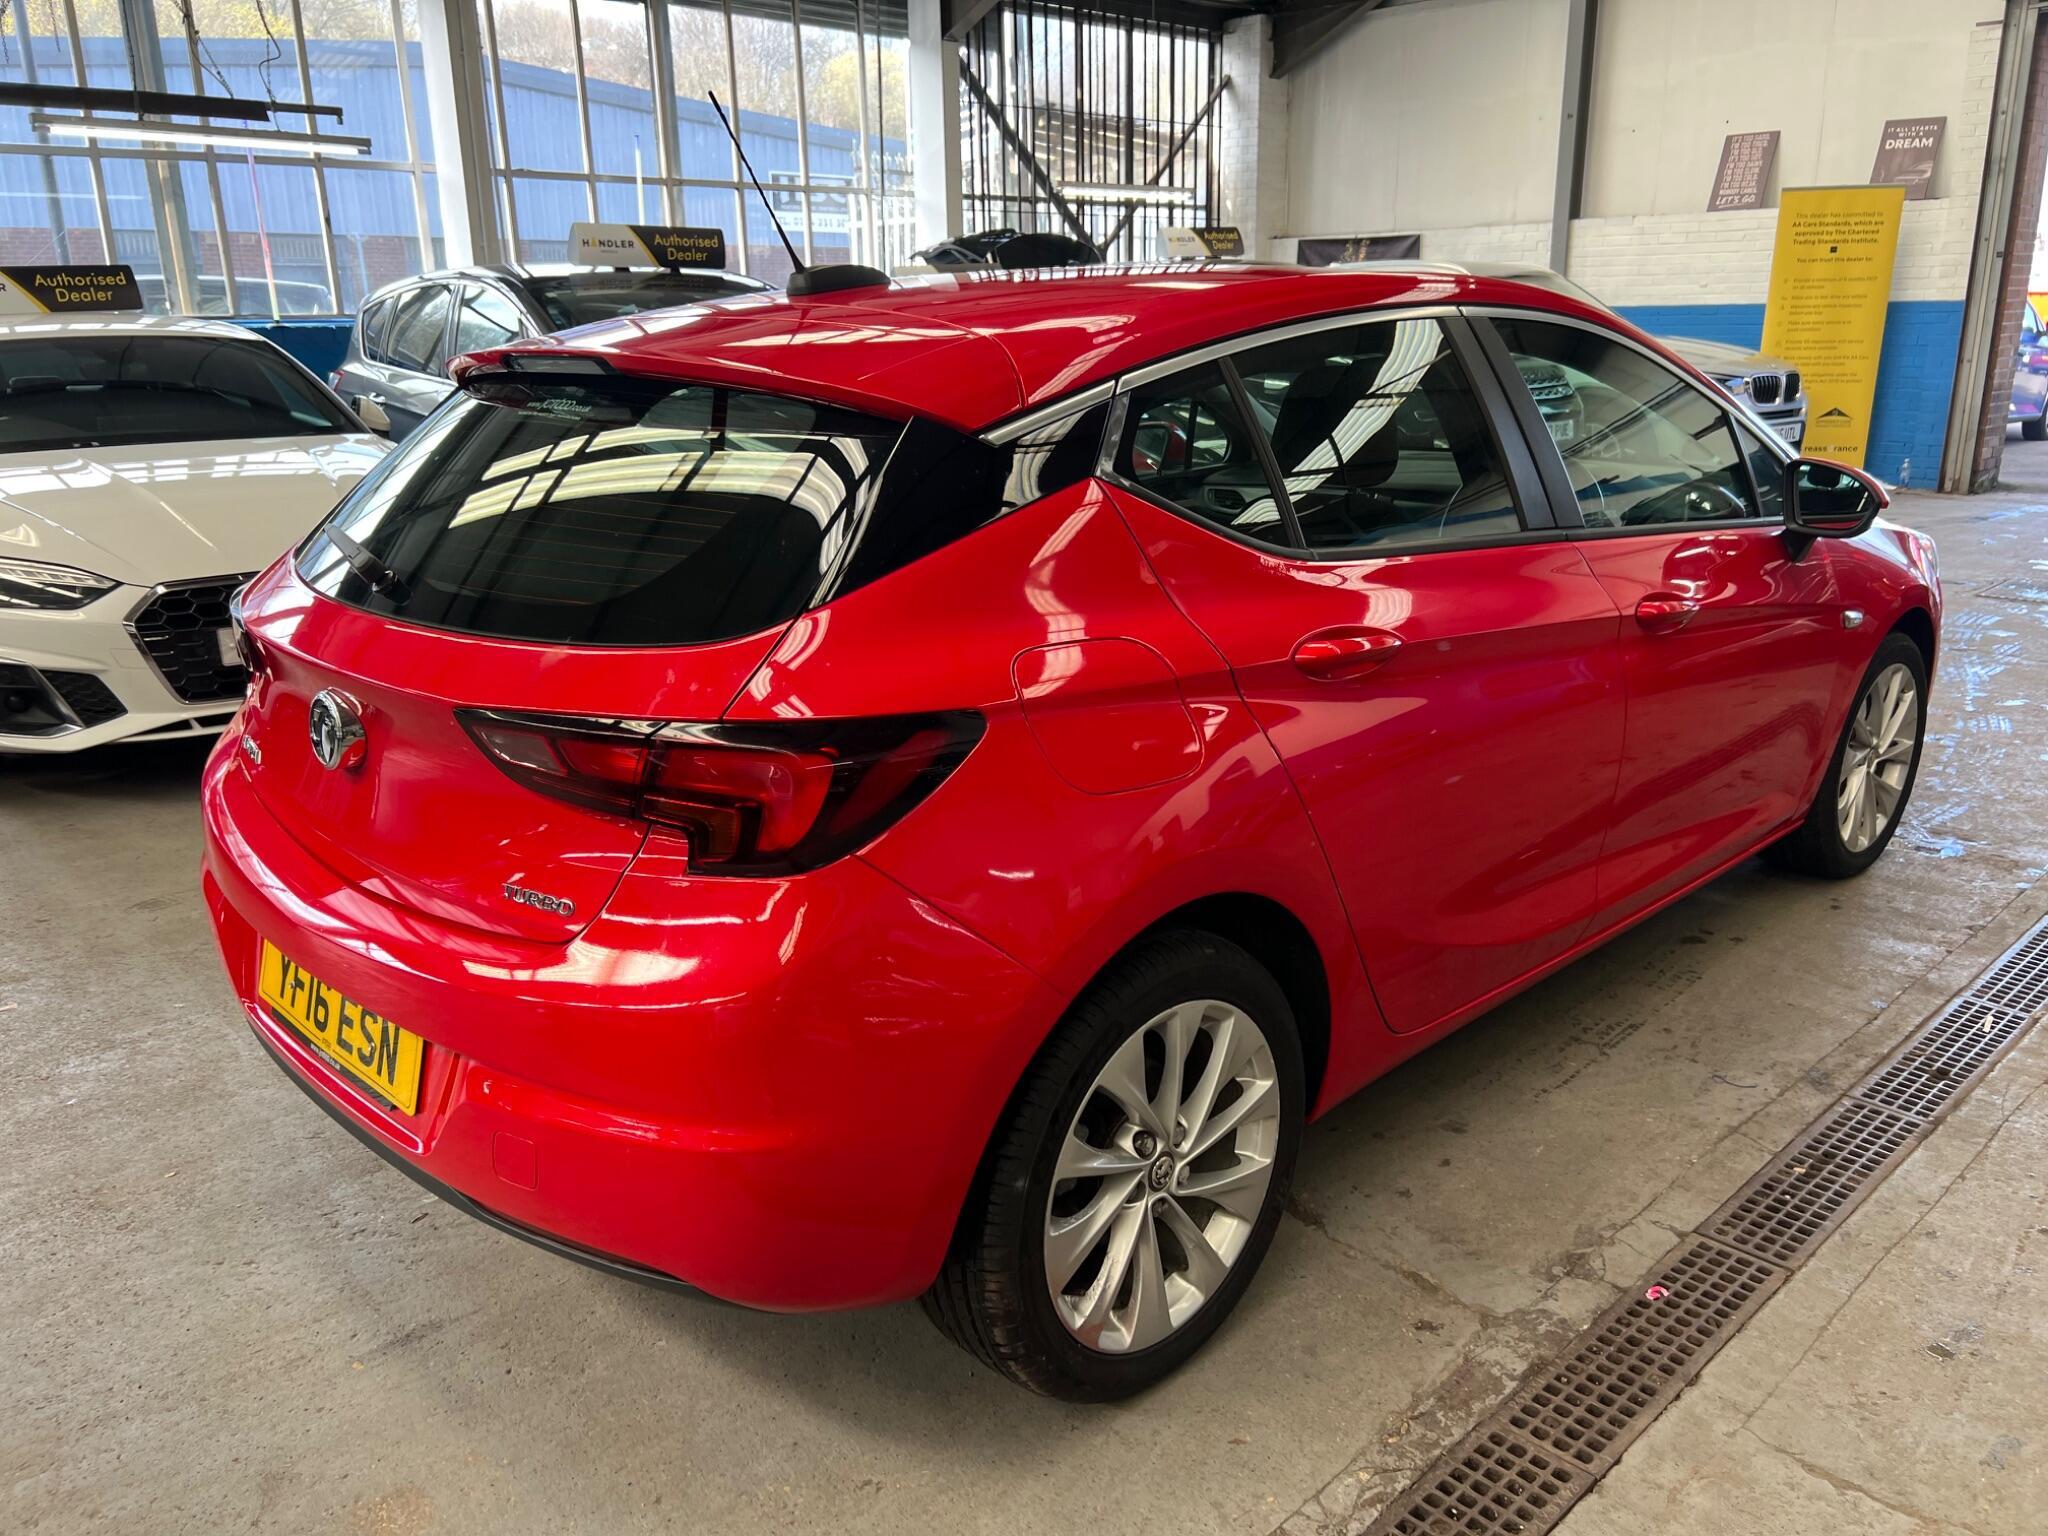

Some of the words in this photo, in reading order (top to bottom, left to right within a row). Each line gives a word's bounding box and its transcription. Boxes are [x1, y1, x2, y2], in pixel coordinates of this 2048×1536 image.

[1911, 124, 1938, 132] STARTS
[1885, 137, 1934, 150] DREAM
[1794, 230, 1825, 238] approved
[1825, 229, 1833, 237] by
[654, 234, 719, 249] Authorised
[667, 248, 708, 262] Dealer
[35, 271, 127, 287] Authorised
[55, 287, 113, 303] Dealer
[1804, 444, 1858, 453] reassrance
[501, 883, 576, 916] TURBO
[279, 953, 330, 1033] YF16
[336, 995, 401, 1086] ESN
